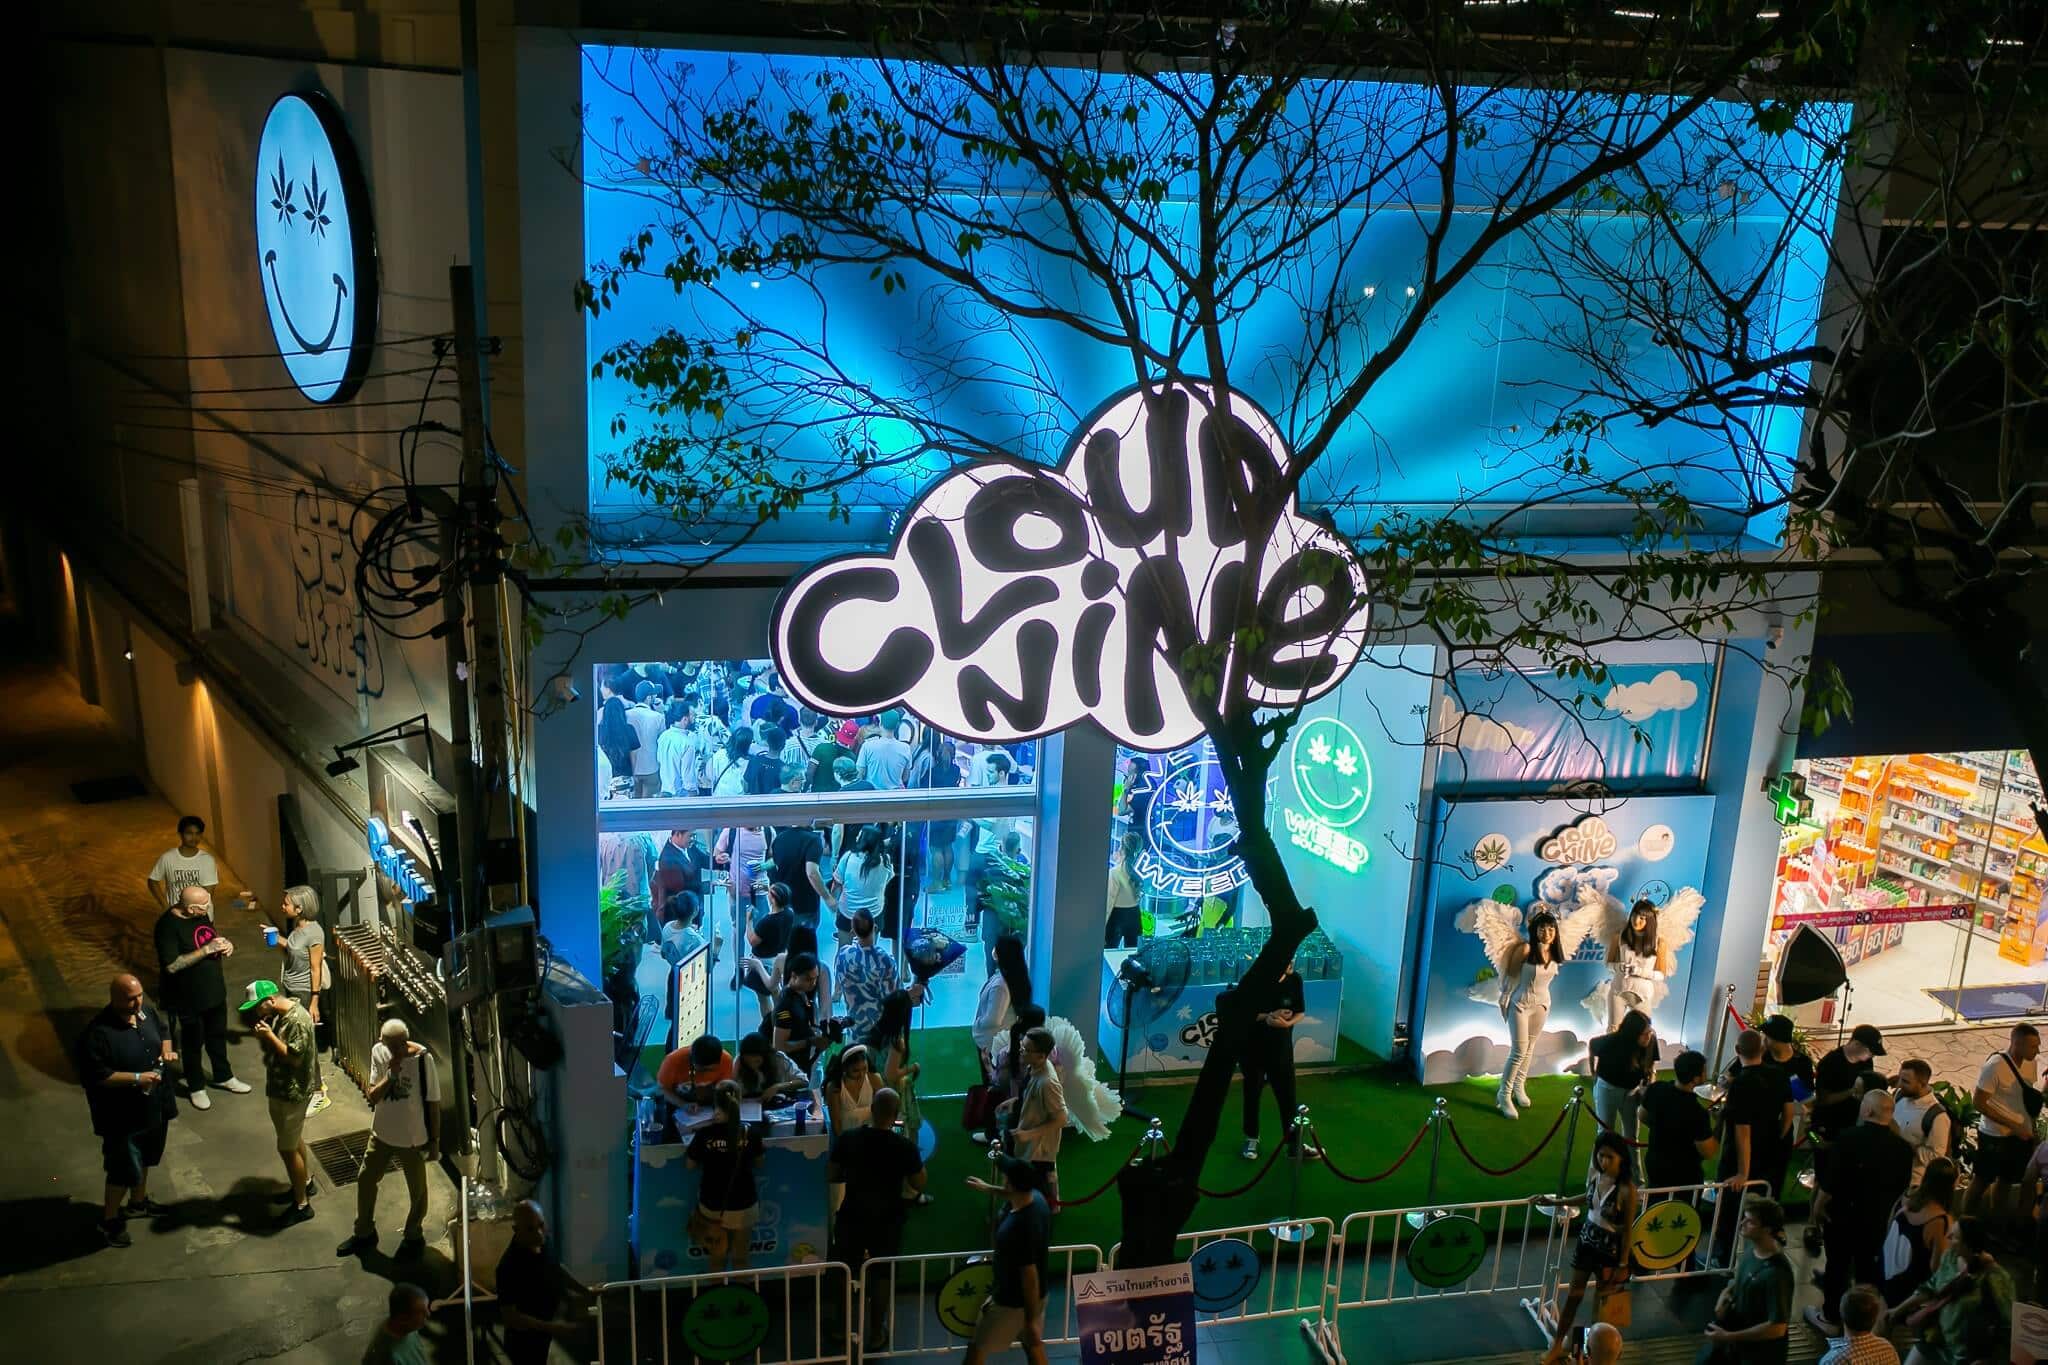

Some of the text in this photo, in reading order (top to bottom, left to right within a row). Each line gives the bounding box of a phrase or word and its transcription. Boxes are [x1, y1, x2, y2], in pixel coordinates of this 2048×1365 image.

[787, 387, 1284, 706] CLOUD
[1285, 808, 1368, 864] WEED
[1544, 822, 1607, 859] CLOUD
[1106, 1272, 1190, 1294] รวมไทยสร้างชาติ
[1094, 1312, 1183, 1355] เขตรัฐ
